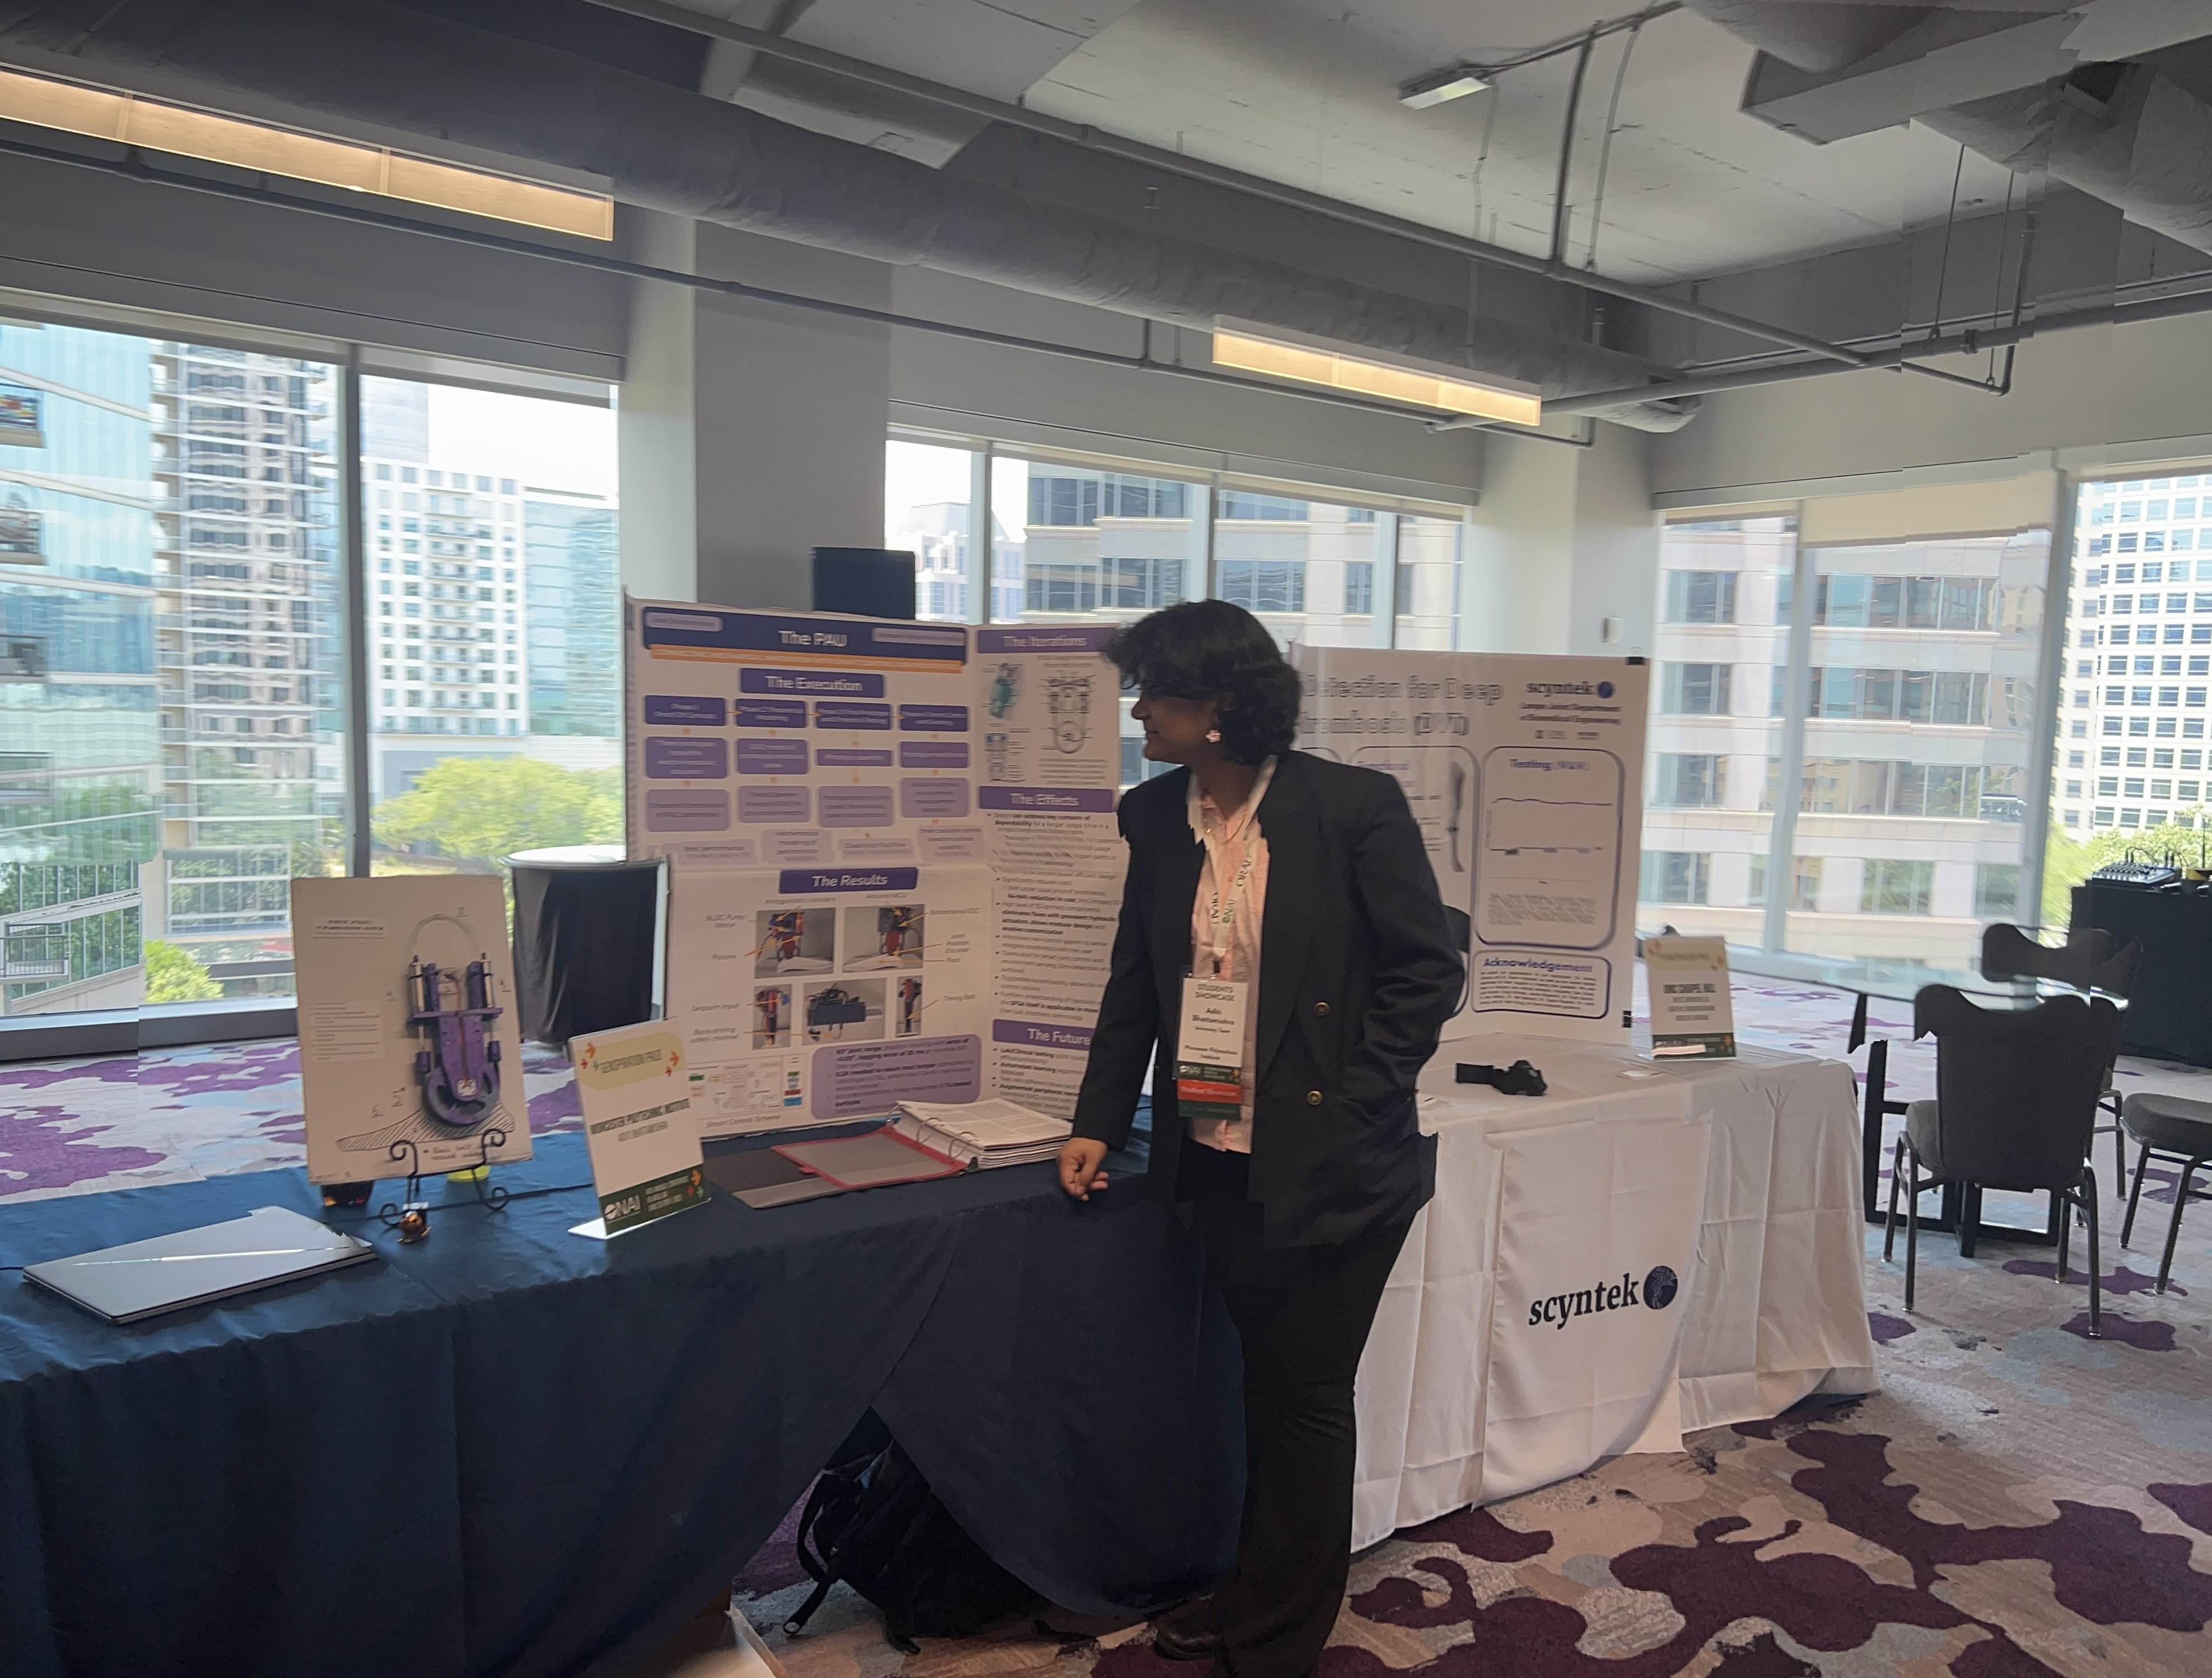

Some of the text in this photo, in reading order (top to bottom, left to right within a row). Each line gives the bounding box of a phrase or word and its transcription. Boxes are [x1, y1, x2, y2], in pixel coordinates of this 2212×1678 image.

[778, 630, 811, 645] The
[1002, 636, 1028, 646] The
[764, 675, 863, 691] The Execution
[1407, 675, 1441, 698] for
[1444, 677, 1505, 706] Deep
[1526, 680, 1595, 697] scyntek
[1009, 793, 1080, 806] The Effects
[812, 874, 889, 887] The Results
[1483, 955, 1593, 973] Acknowledgement
[1027, 1028, 1091, 1046] The Future
[1528, 1272, 1640, 1330] scyntek
